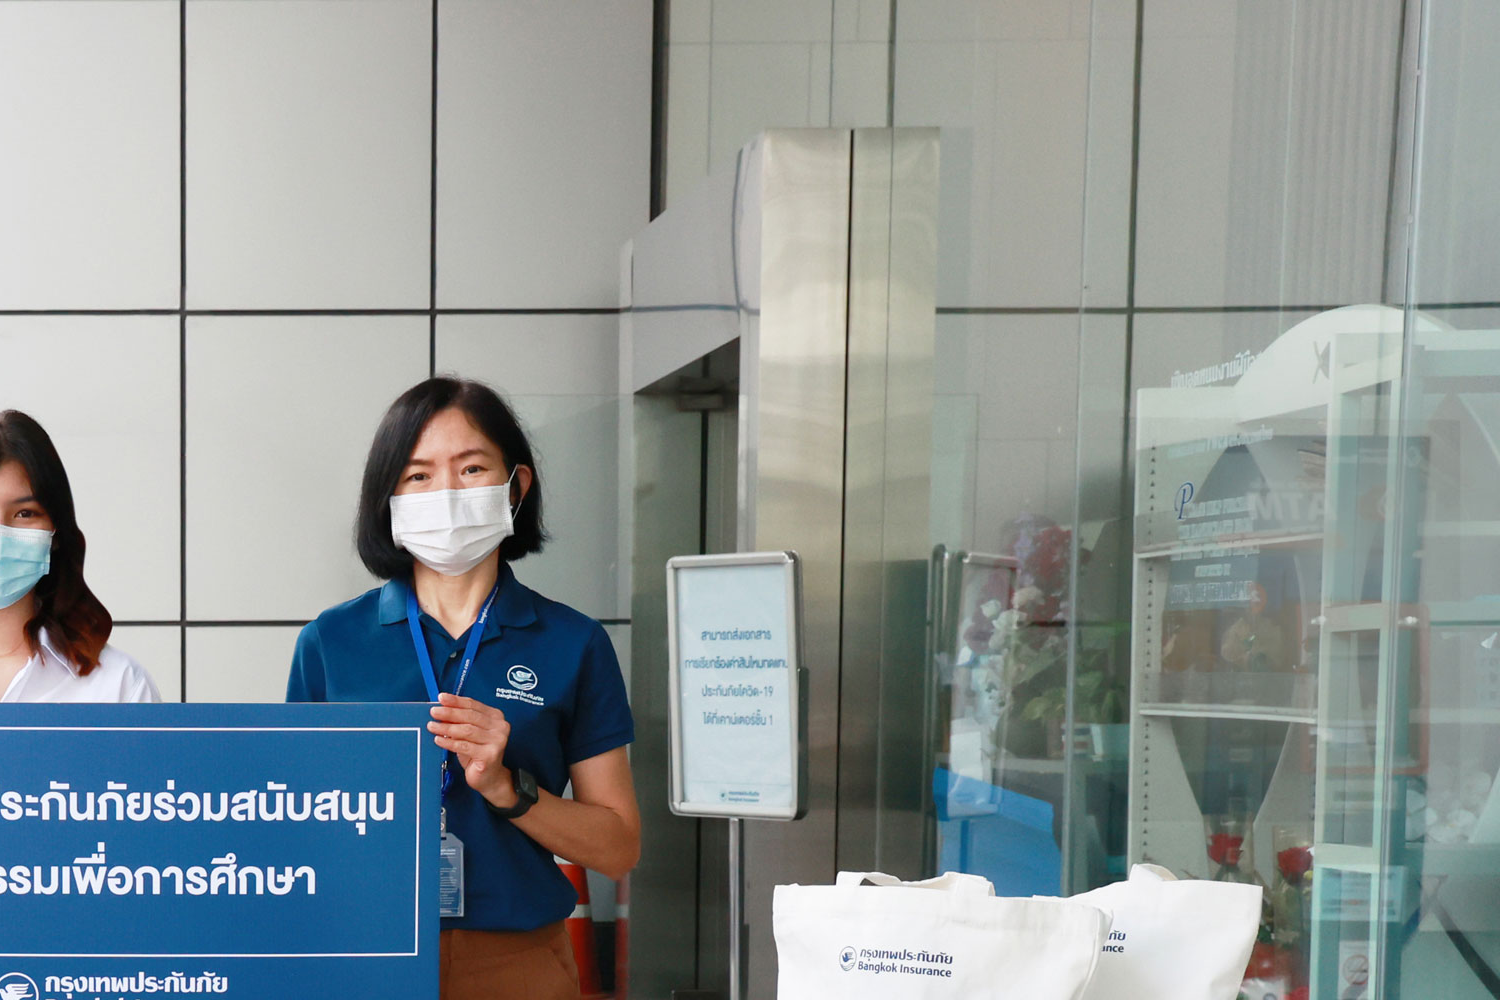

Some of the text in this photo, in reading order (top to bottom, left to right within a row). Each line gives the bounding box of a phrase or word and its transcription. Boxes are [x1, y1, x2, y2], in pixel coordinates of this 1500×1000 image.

[860, 948, 953, 965] กรุงเทพประกันภัย
[858, 960, 952, 978] Bangkok Insurance
[45, 971, 228, 999] กรุงเทพประกันภัย
